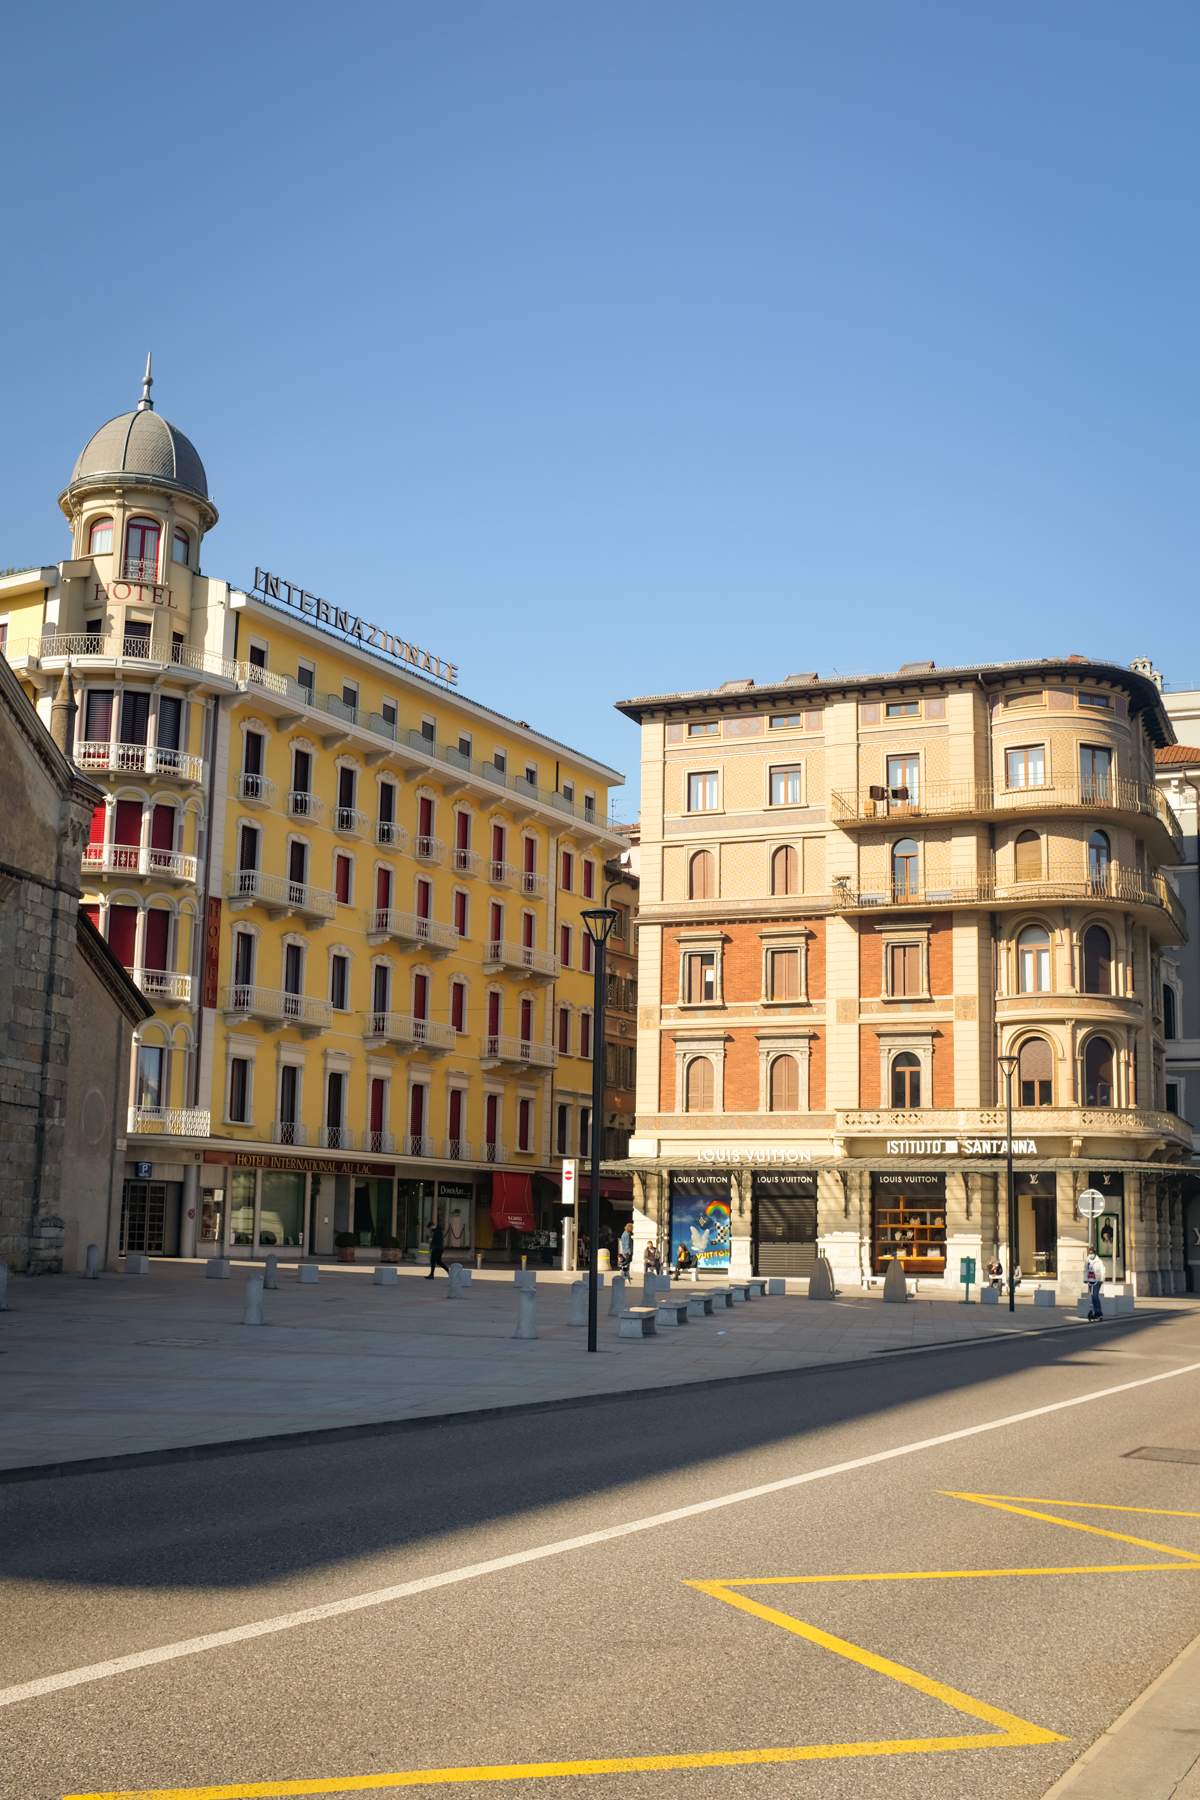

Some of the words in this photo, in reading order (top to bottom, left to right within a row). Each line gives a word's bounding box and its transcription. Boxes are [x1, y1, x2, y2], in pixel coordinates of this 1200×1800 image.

[93, 582, 178, 609] HOTEL
[254, 566, 459, 686] INTERNAZIONALE
[207, 902, 221, 1001] HOTEL
[886, 1139, 942, 1154] ISTITUTO
[963, 1139, 1038, 1154] SANT'ANNA
[236, 1154, 267, 1167] HOTEL
[270, 1156, 338, 1172] INTERNATIONAL
[341, 1162, 354, 1173] AU
[356, 1164, 372, 1174] LAC
[697, 1149, 740, 1162] LOUIS
[746, 1149, 811, 1162] VUITTON
[673, 1176, 695, 1184] LOUIS
[696, 1176, 728, 1184] VUITTON
[757, 1176, 779, 1184] LOUIS
[780, 1176, 813, 1184] VUITTON
